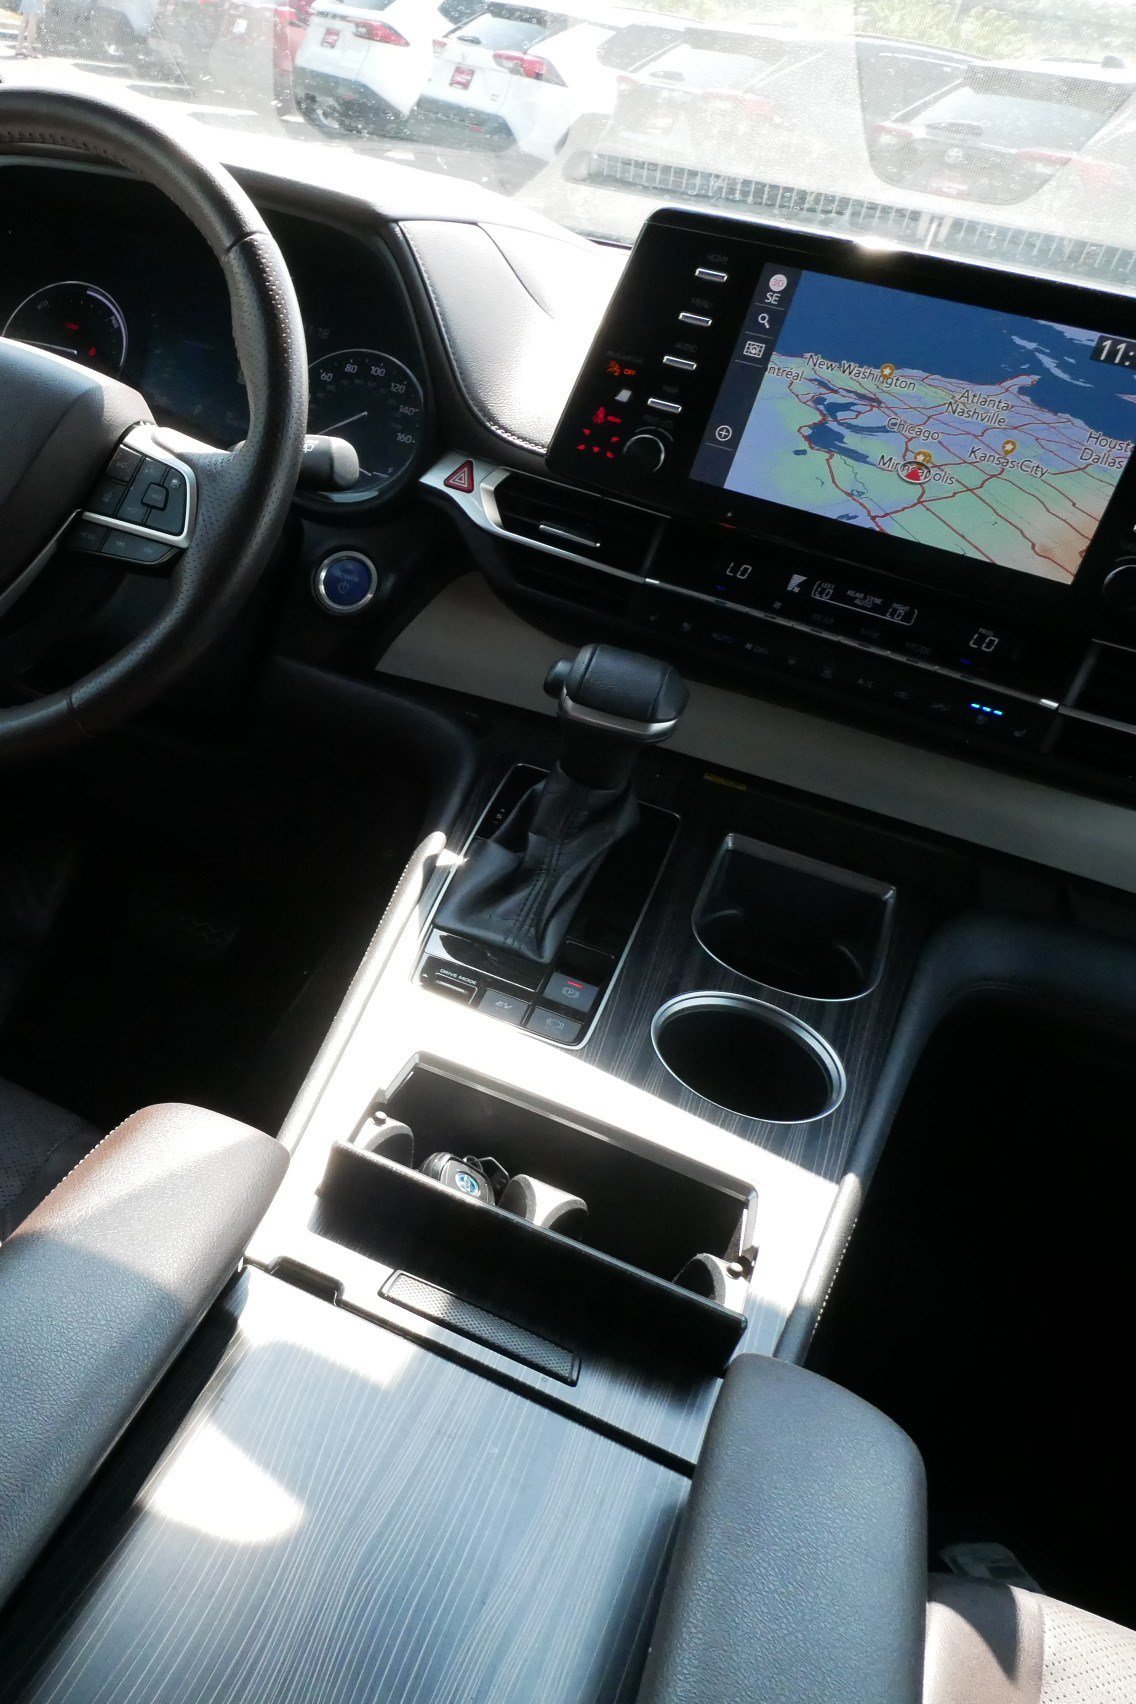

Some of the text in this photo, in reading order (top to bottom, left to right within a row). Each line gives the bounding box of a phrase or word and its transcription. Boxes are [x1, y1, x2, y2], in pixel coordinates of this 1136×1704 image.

[764, 292, 781, 304] SE
[1099, 340, 1134, 366] 11:
[344, 364, 358, 374] 80
[806, 354, 837, 371] New
[320, 372, 333, 382] 60
[370, 366, 385, 377] 100
[841, 361, 916, 391] Washington
[390, 382, 405, 394] 120
[959, 389, 1009, 411] Atlanta
[399, 405, 415, 416] 140
[945, 401, 1006, 427] Nashville
[886, 417, 940, 442] Chicago
[397, 433, 413, 444] 160
[968, 446, 1048, 479] Kansas City
[1079, 448, 1124, 469] Dallas
[439, 968, 477, 985] DRIVE MODE
[494, 1001, 513, 1010] EV
